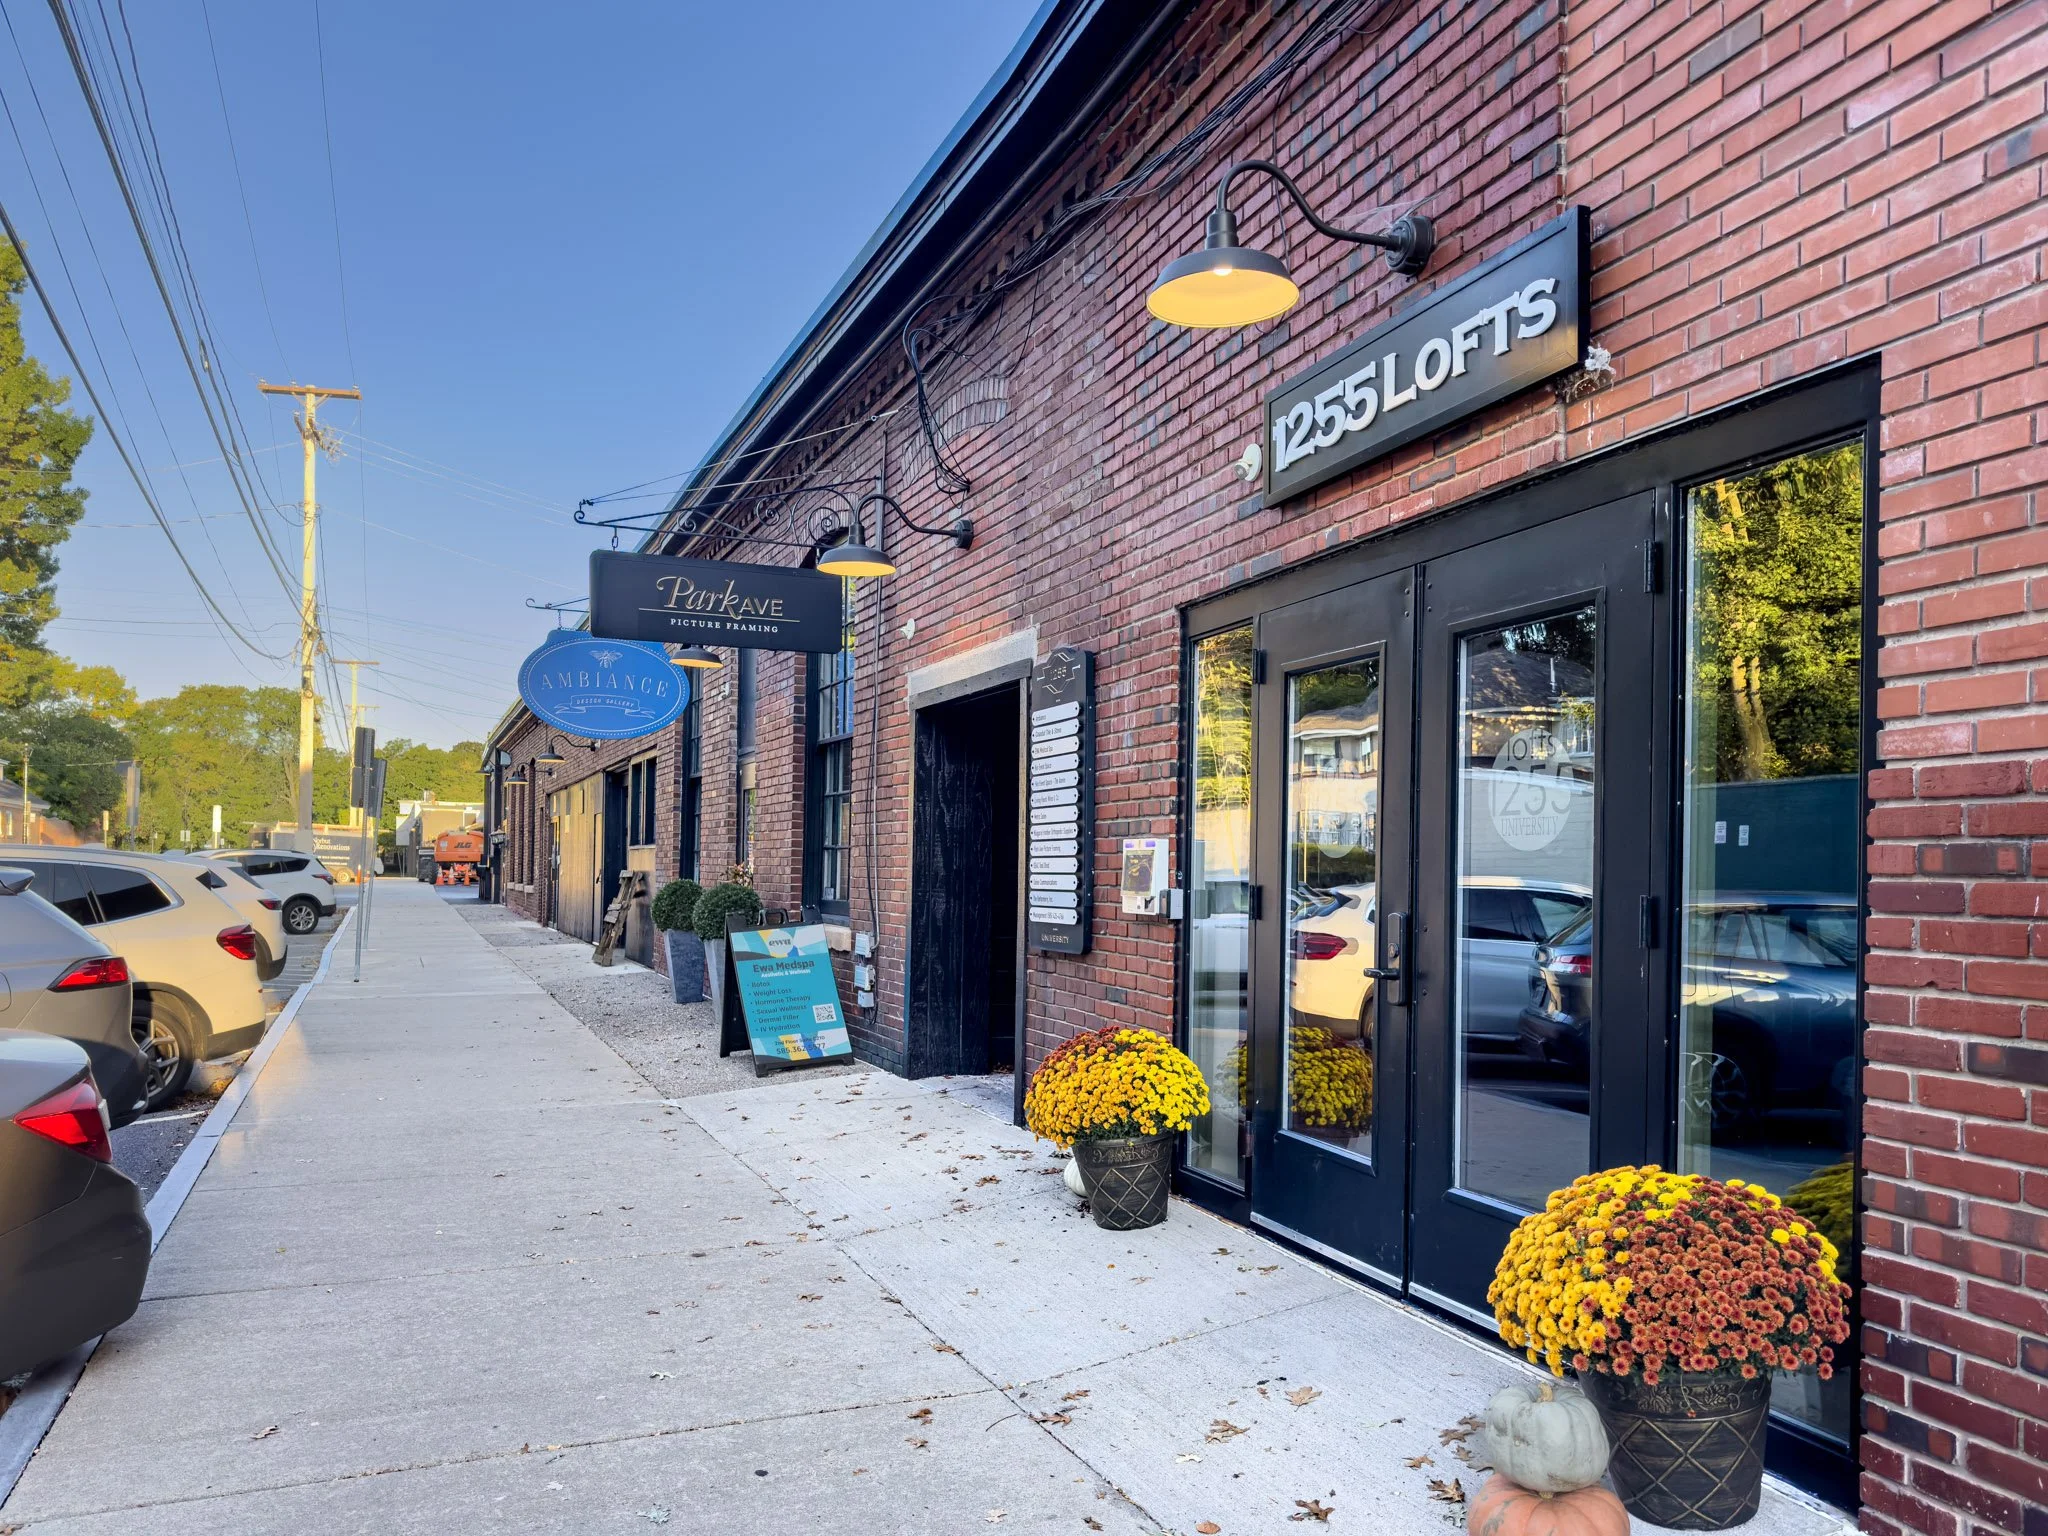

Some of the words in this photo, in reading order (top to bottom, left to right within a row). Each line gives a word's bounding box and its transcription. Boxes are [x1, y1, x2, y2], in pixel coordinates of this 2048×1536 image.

[1272, 361, 1379, 473] 1255
[1382, 278, 1557, 413] LOFTS
[656, 576, 742, 620] Park
[739, 596, 783, 617] AVE
[670, 618, 721, 630] PICTURE
[726, 623, 779, 633] FRAMING
[541, 670, 669, 698] AMBIANCE
[1500, 815, 1559, 837] UNIVERSITY
[768, 938, 791, 947] ewa
[753, 963, 773, 973] Ewa
[775, 959, 815, 971] Medspa
[753, 990, 776, 998] Weight
[777, 987, 792, 995] Loss
[755, 998, 785, 1006] Hormone
[786, 995, 811, 1003] Therapy
[758, 1016, 782, 1024] Dermal
[768, 1023, 801, 1033] Hydration
